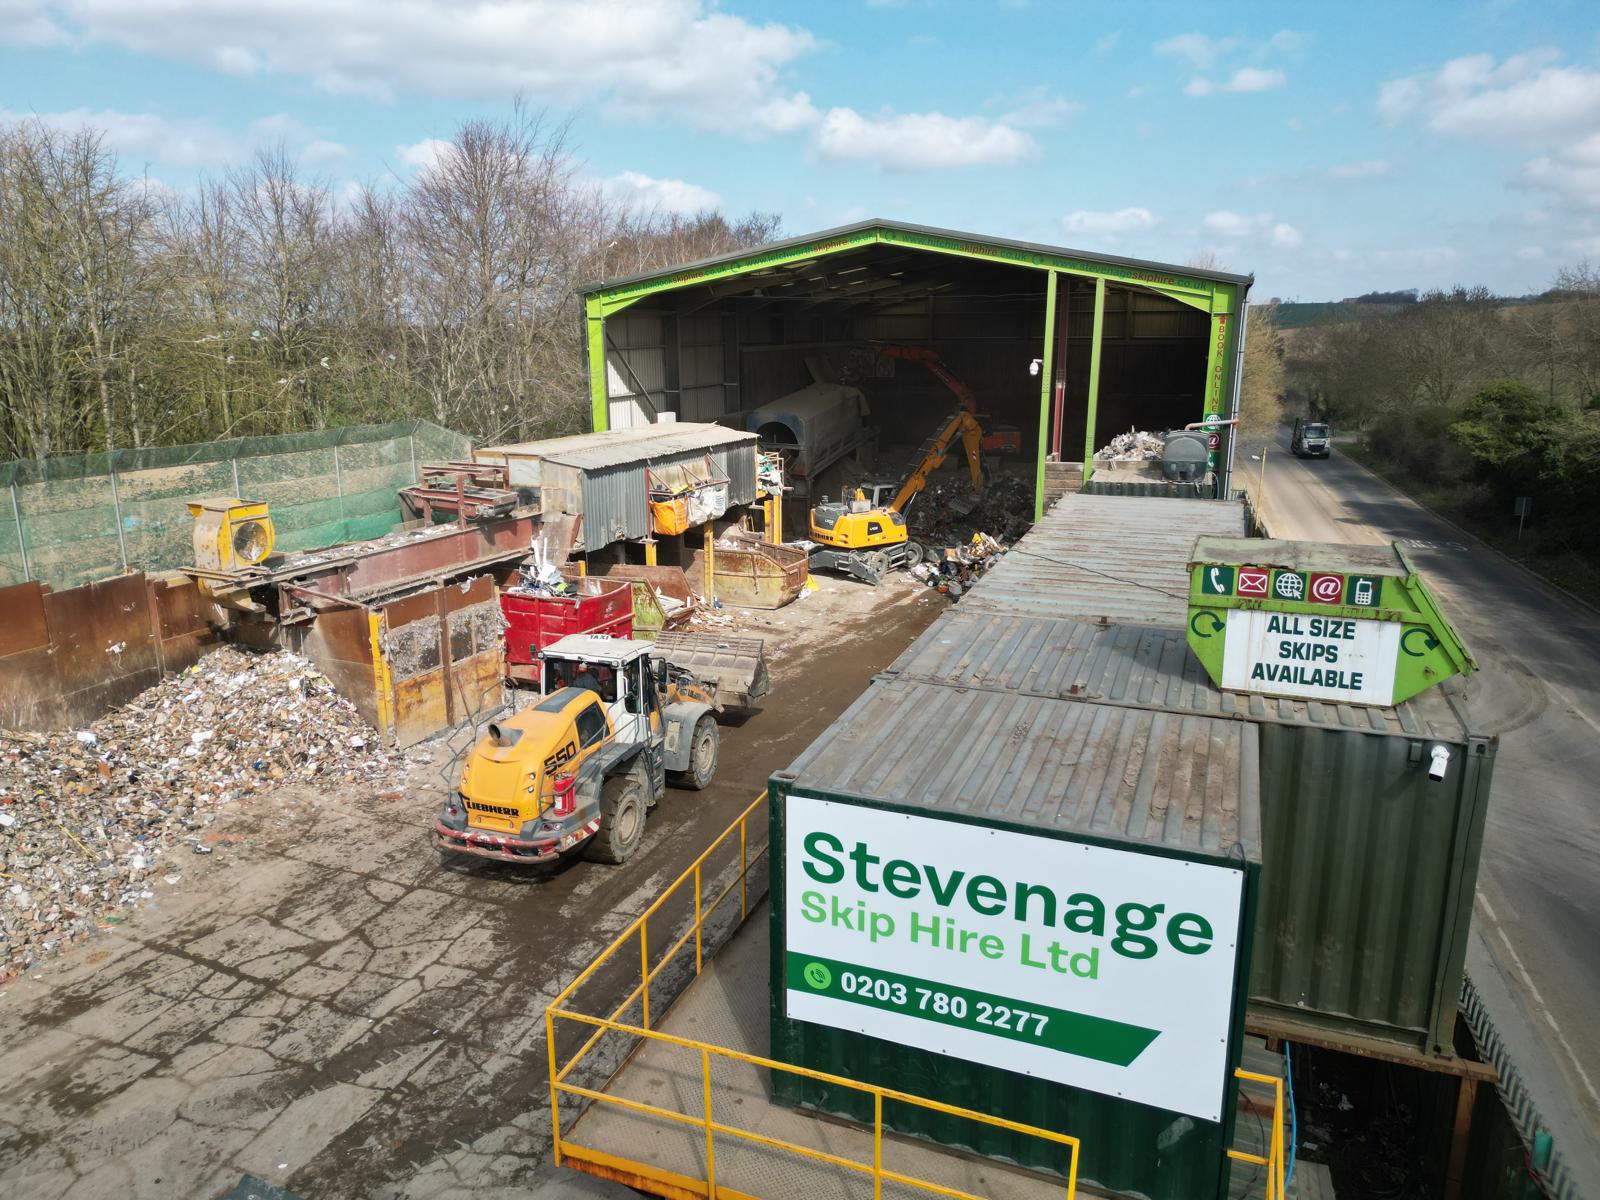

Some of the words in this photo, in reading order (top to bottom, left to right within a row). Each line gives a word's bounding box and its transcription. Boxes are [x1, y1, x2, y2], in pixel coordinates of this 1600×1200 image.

[1216, 325, 1225, 357] BOOK
[1211, 365, 1222, 412] ONLINE
[1267, 615, 1305, 635] ALL
[1309, 618, 1356, 640] SIZE
[1278, 641, 1338, 663] SKIPS
[1251, 662, 1363, 690] AVAILABLE
[466, 801, 520, 817] LIEBHERR
[801, 831, 1214, 960] Stevenage
[800, 890, 896, 943] Skip
[910, 911, 1005, 960] Hire
[1020, 933, 1100, 980] Ltd
[840, 972, 907, 1005] 0203
[915, 987, 968, 1019] 780
[976, 1002, 1049, 1037] 2277
